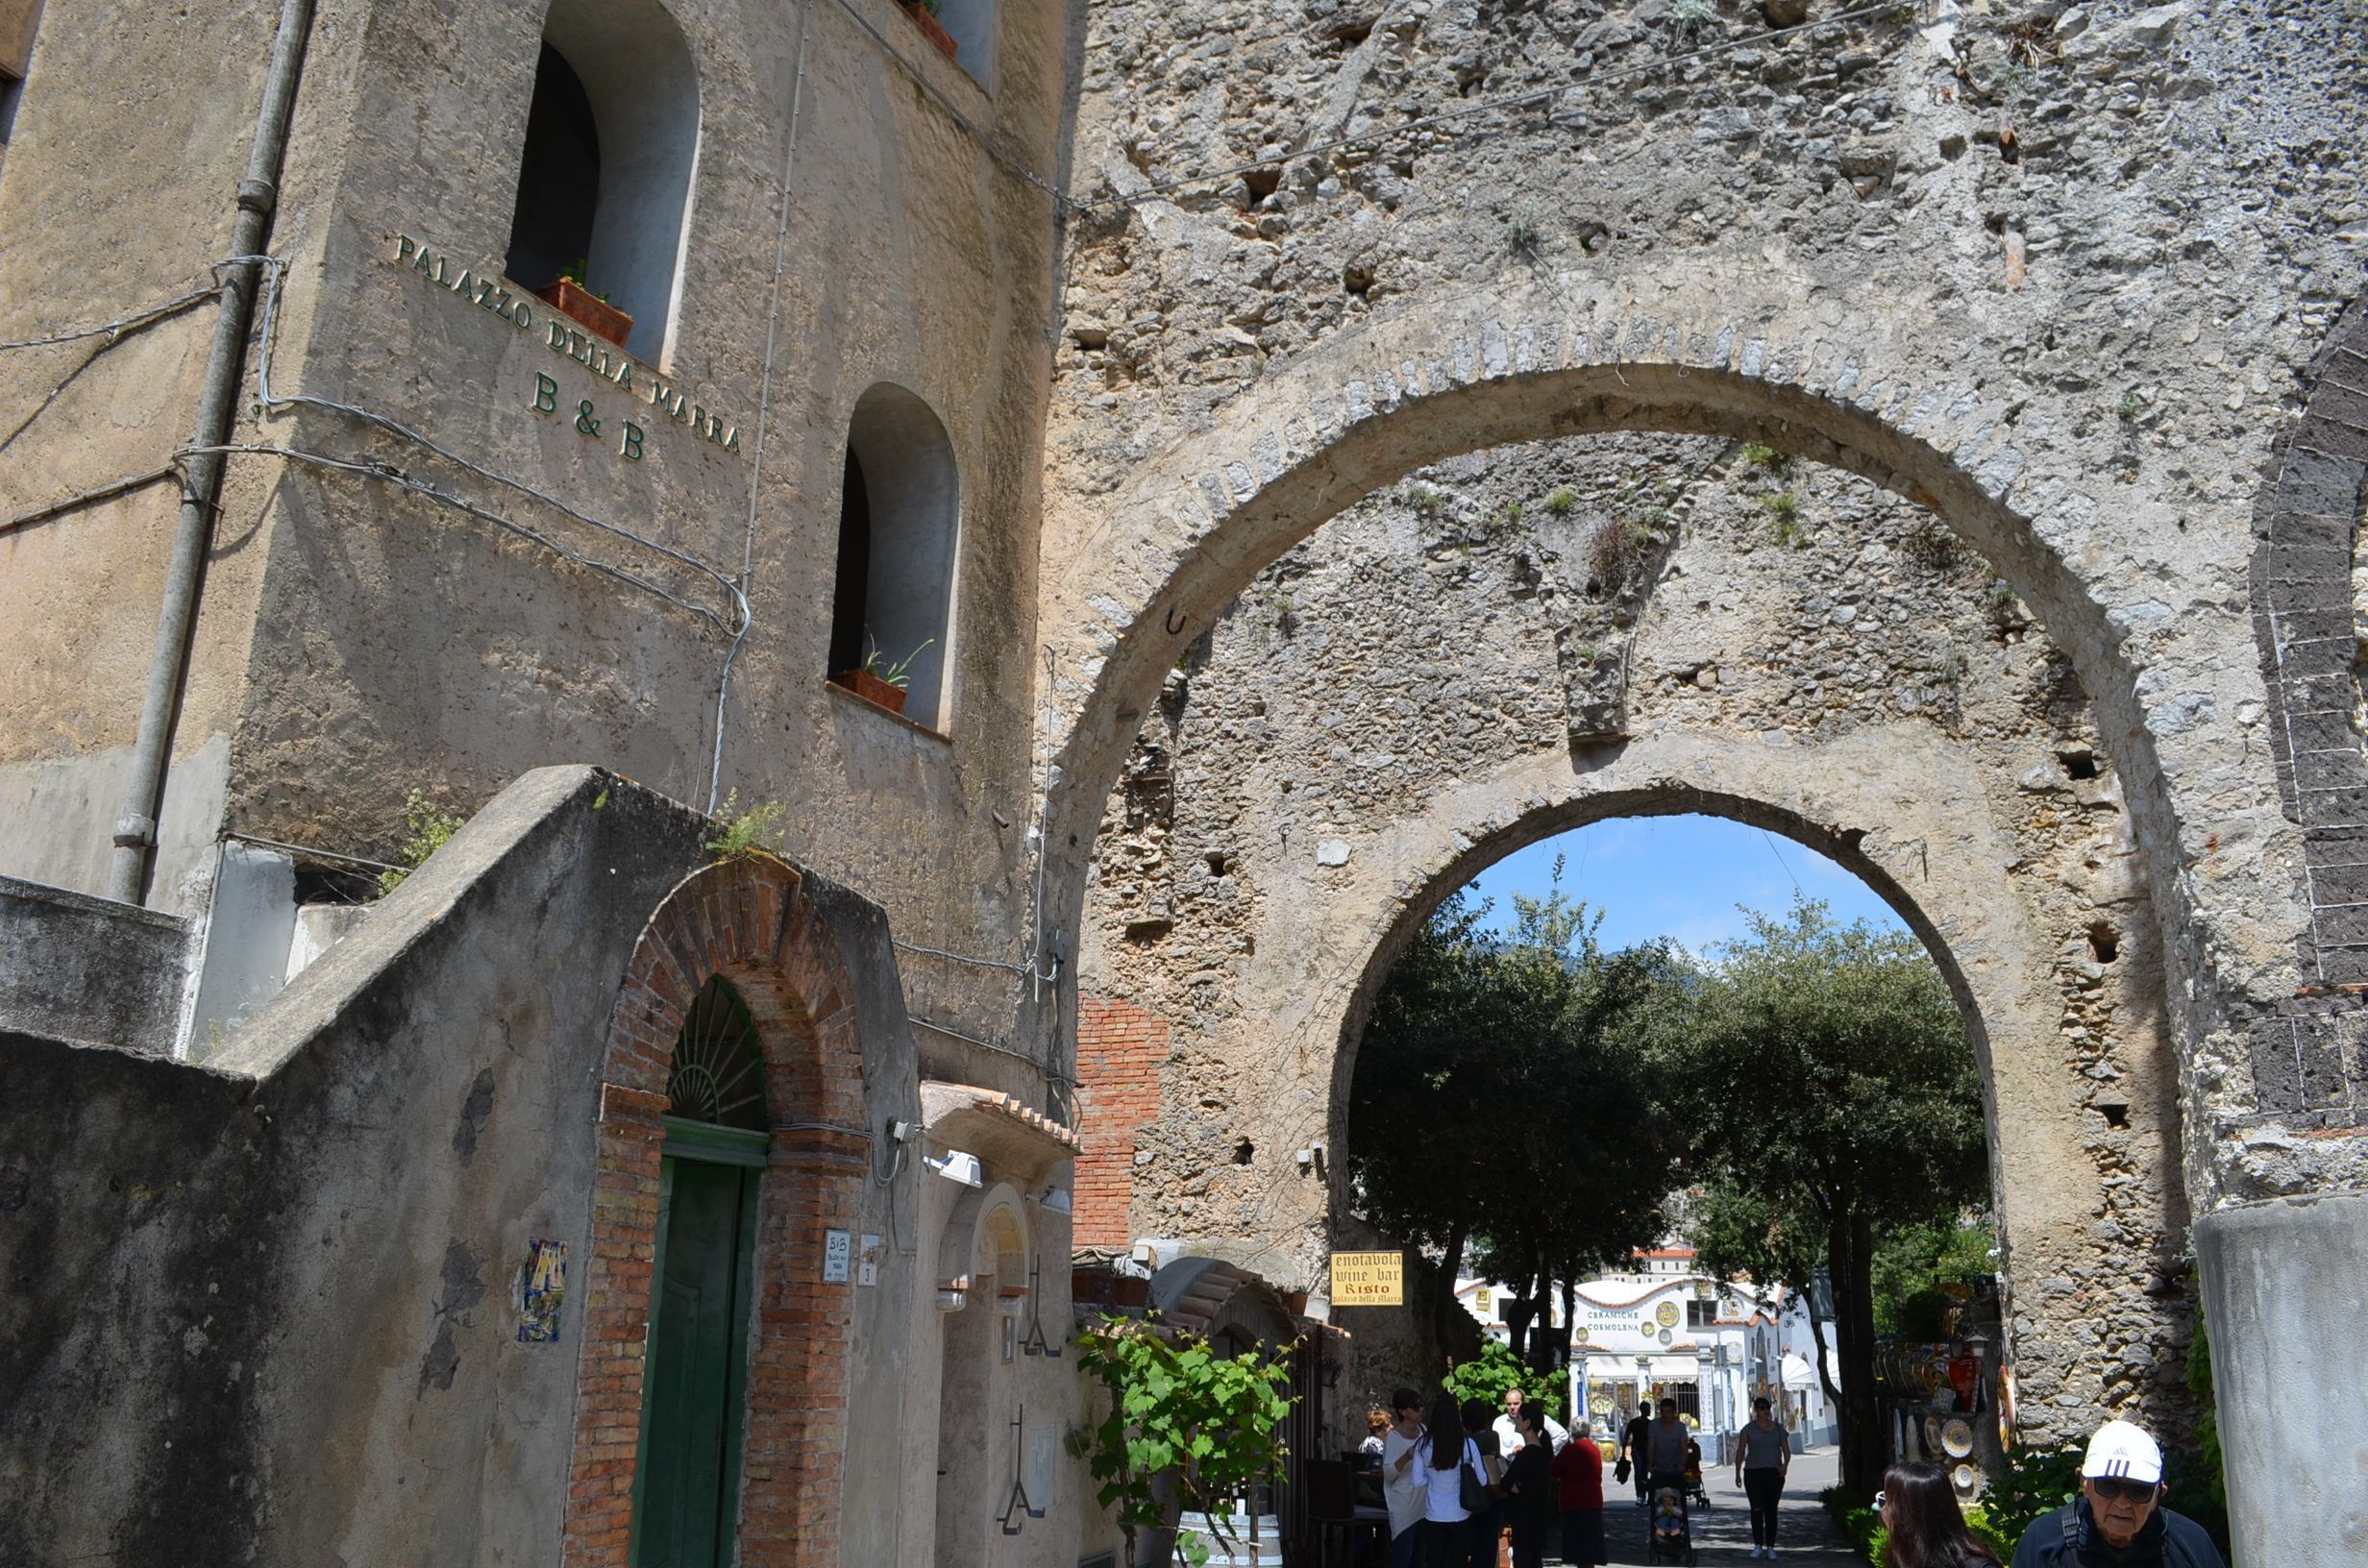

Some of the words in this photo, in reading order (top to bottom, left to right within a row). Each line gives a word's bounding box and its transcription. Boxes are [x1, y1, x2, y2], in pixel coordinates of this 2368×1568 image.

[395, 234, 531, 330] PALAZZO
[547, 320, 632, 393] DELLA
[651, 380, 740, 454] MARRA
[532, 371, 558, 414] B
[575, 399, 602, 437] &
[620, 419, 645, 460] B
[1336, 1253, 1401, 1266] enotavola
[865, 1268, 870, 1283] 3
[1335, 1269, 1369, 1282] wine
[1377, 1268, 1400, 1281] bar
[1345, 1284, 1390, 1294] Risto
